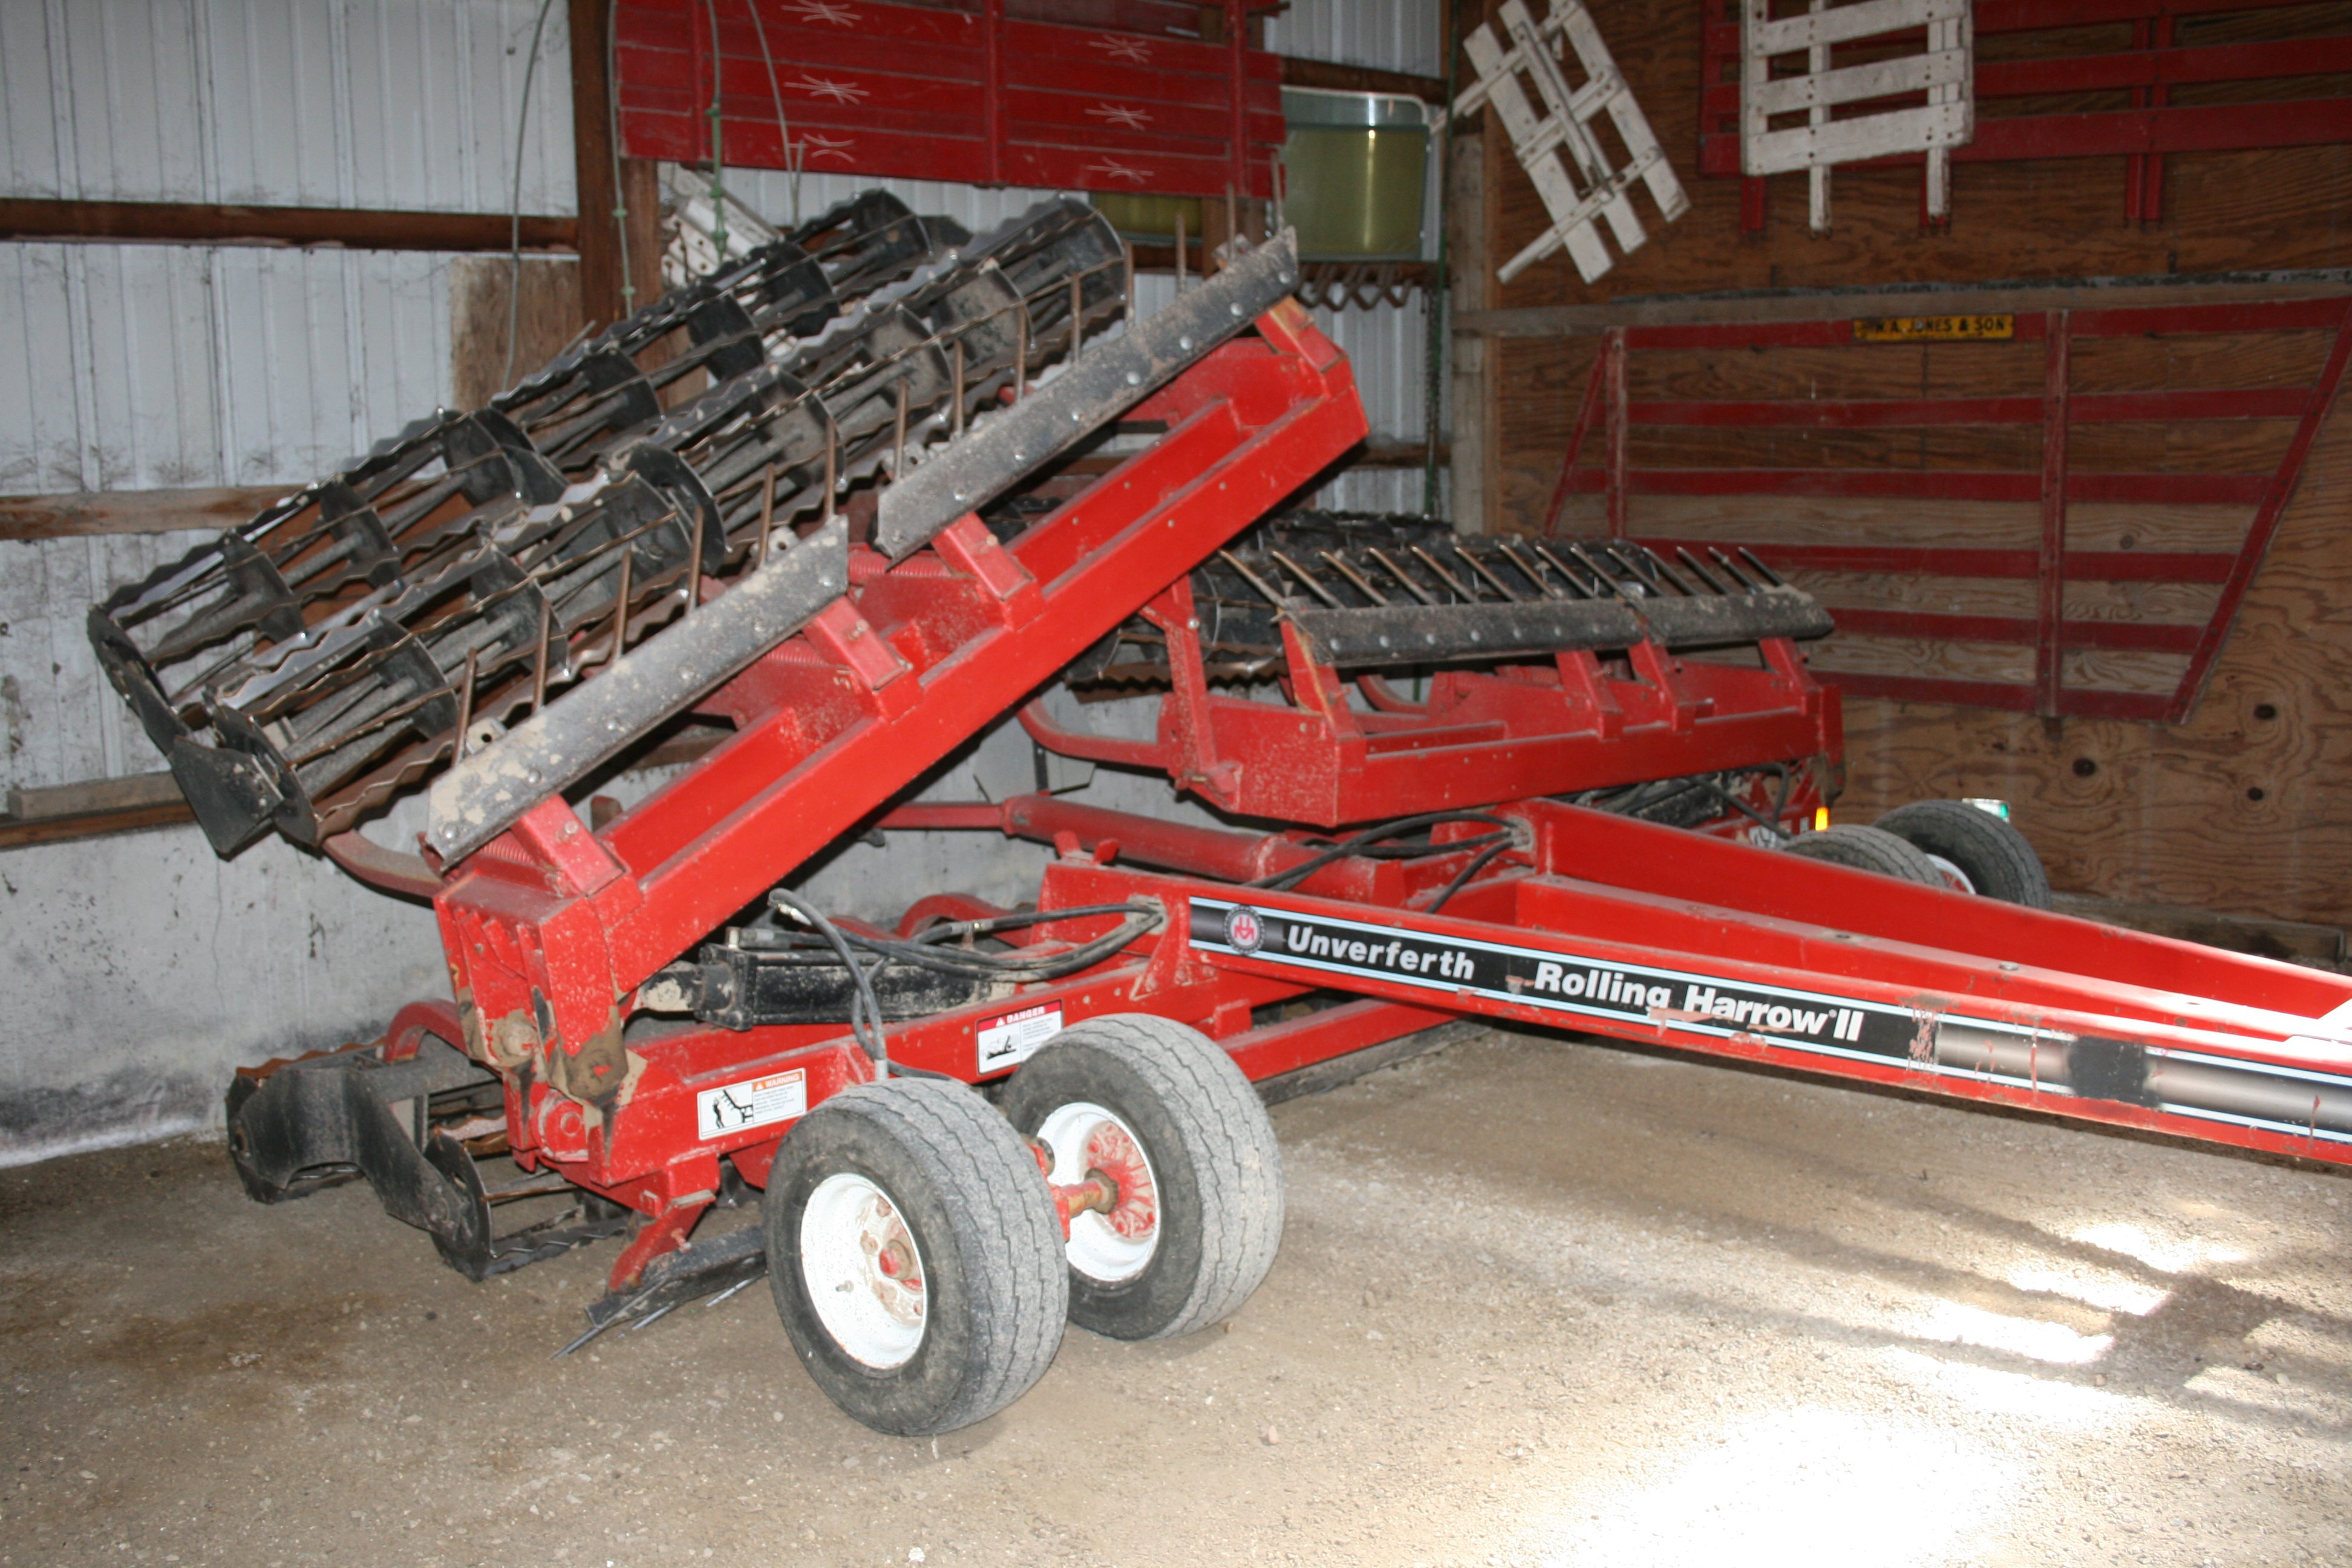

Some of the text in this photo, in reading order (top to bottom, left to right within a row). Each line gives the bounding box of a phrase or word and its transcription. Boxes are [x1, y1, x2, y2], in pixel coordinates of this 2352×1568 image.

[1974, 317, 2005, 331] SON
[1287, 925, 1475, 980] Unverferth
[1534, 961, 1671, 1009] Rolling
[1006, 1005, 1045, 1024] DANGER
[765, 1073, 799, 1088] WARNING
